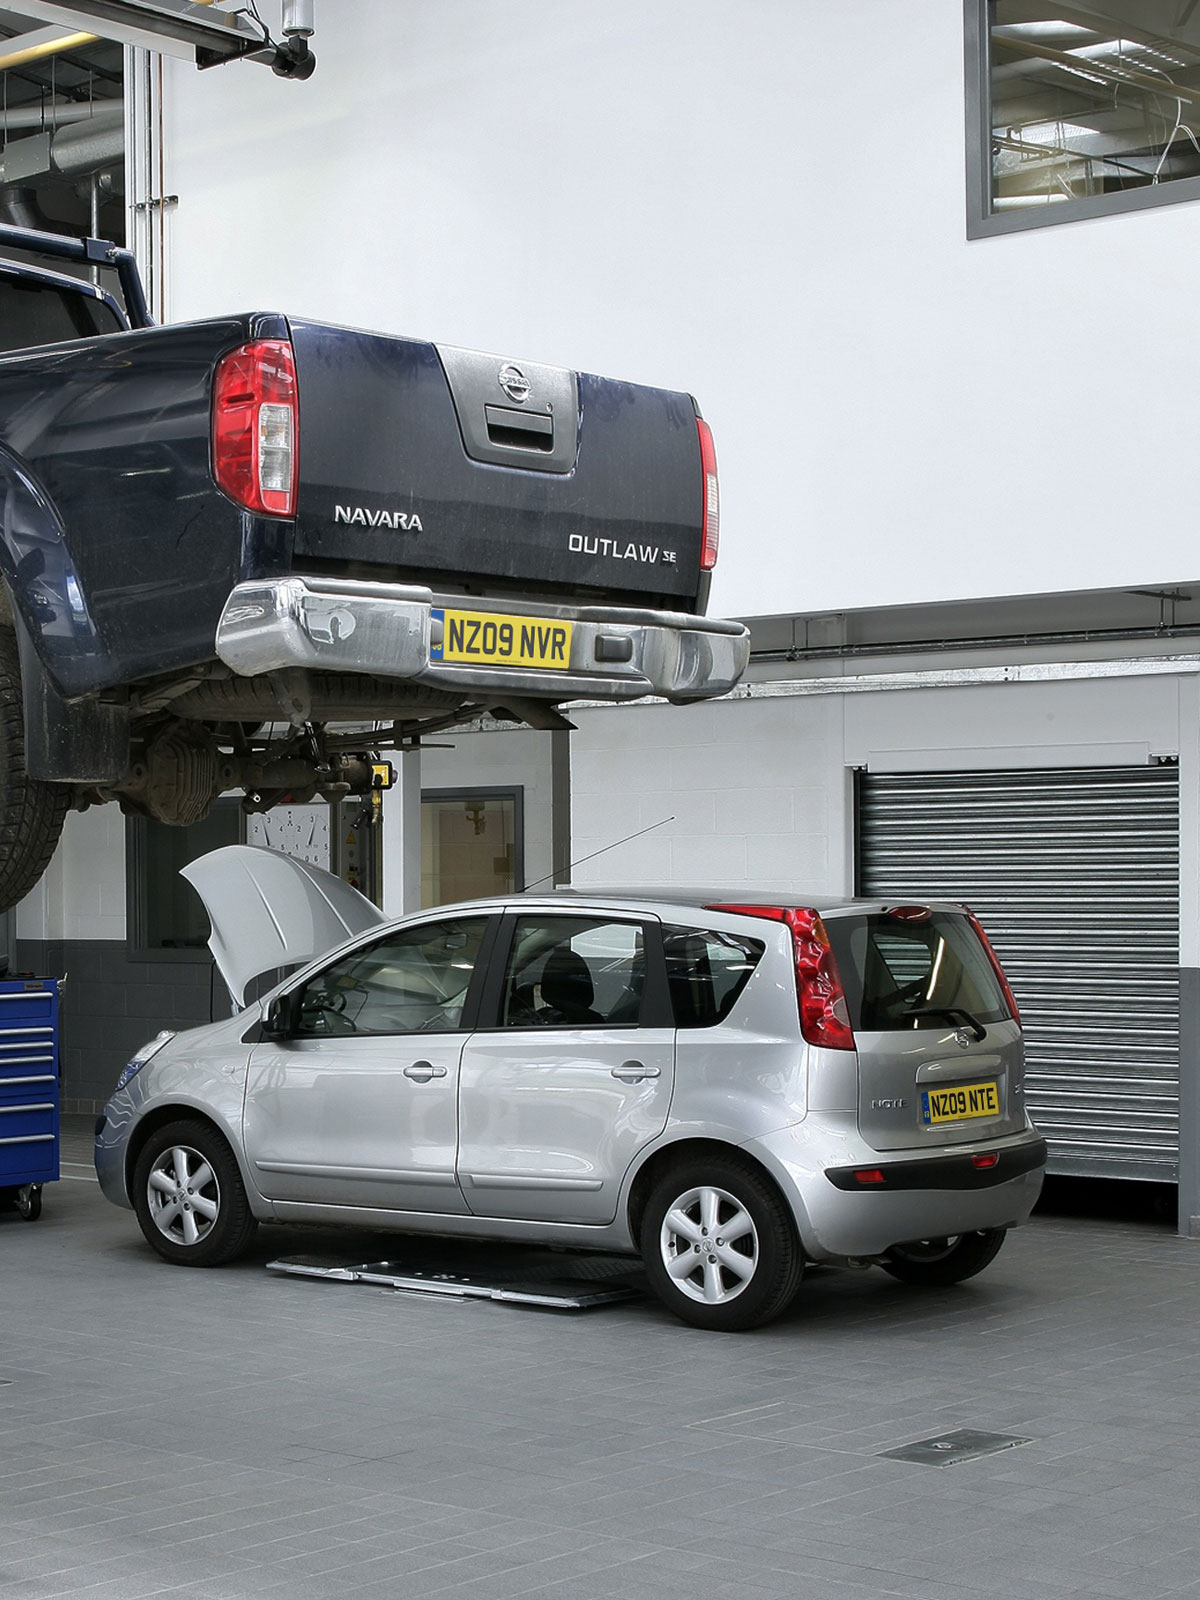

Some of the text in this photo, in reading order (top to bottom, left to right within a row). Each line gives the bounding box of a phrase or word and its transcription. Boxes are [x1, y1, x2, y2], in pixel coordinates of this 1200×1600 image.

[334, 504, 424, 532] NAVARA
[568, 533, 677, 563] OUTLAW SE
[448, 618, 567, 661] NZ09 NVR
[931, 1092, 967, 1117] NZ09
[969, 1087, 996, 1112] NTE
